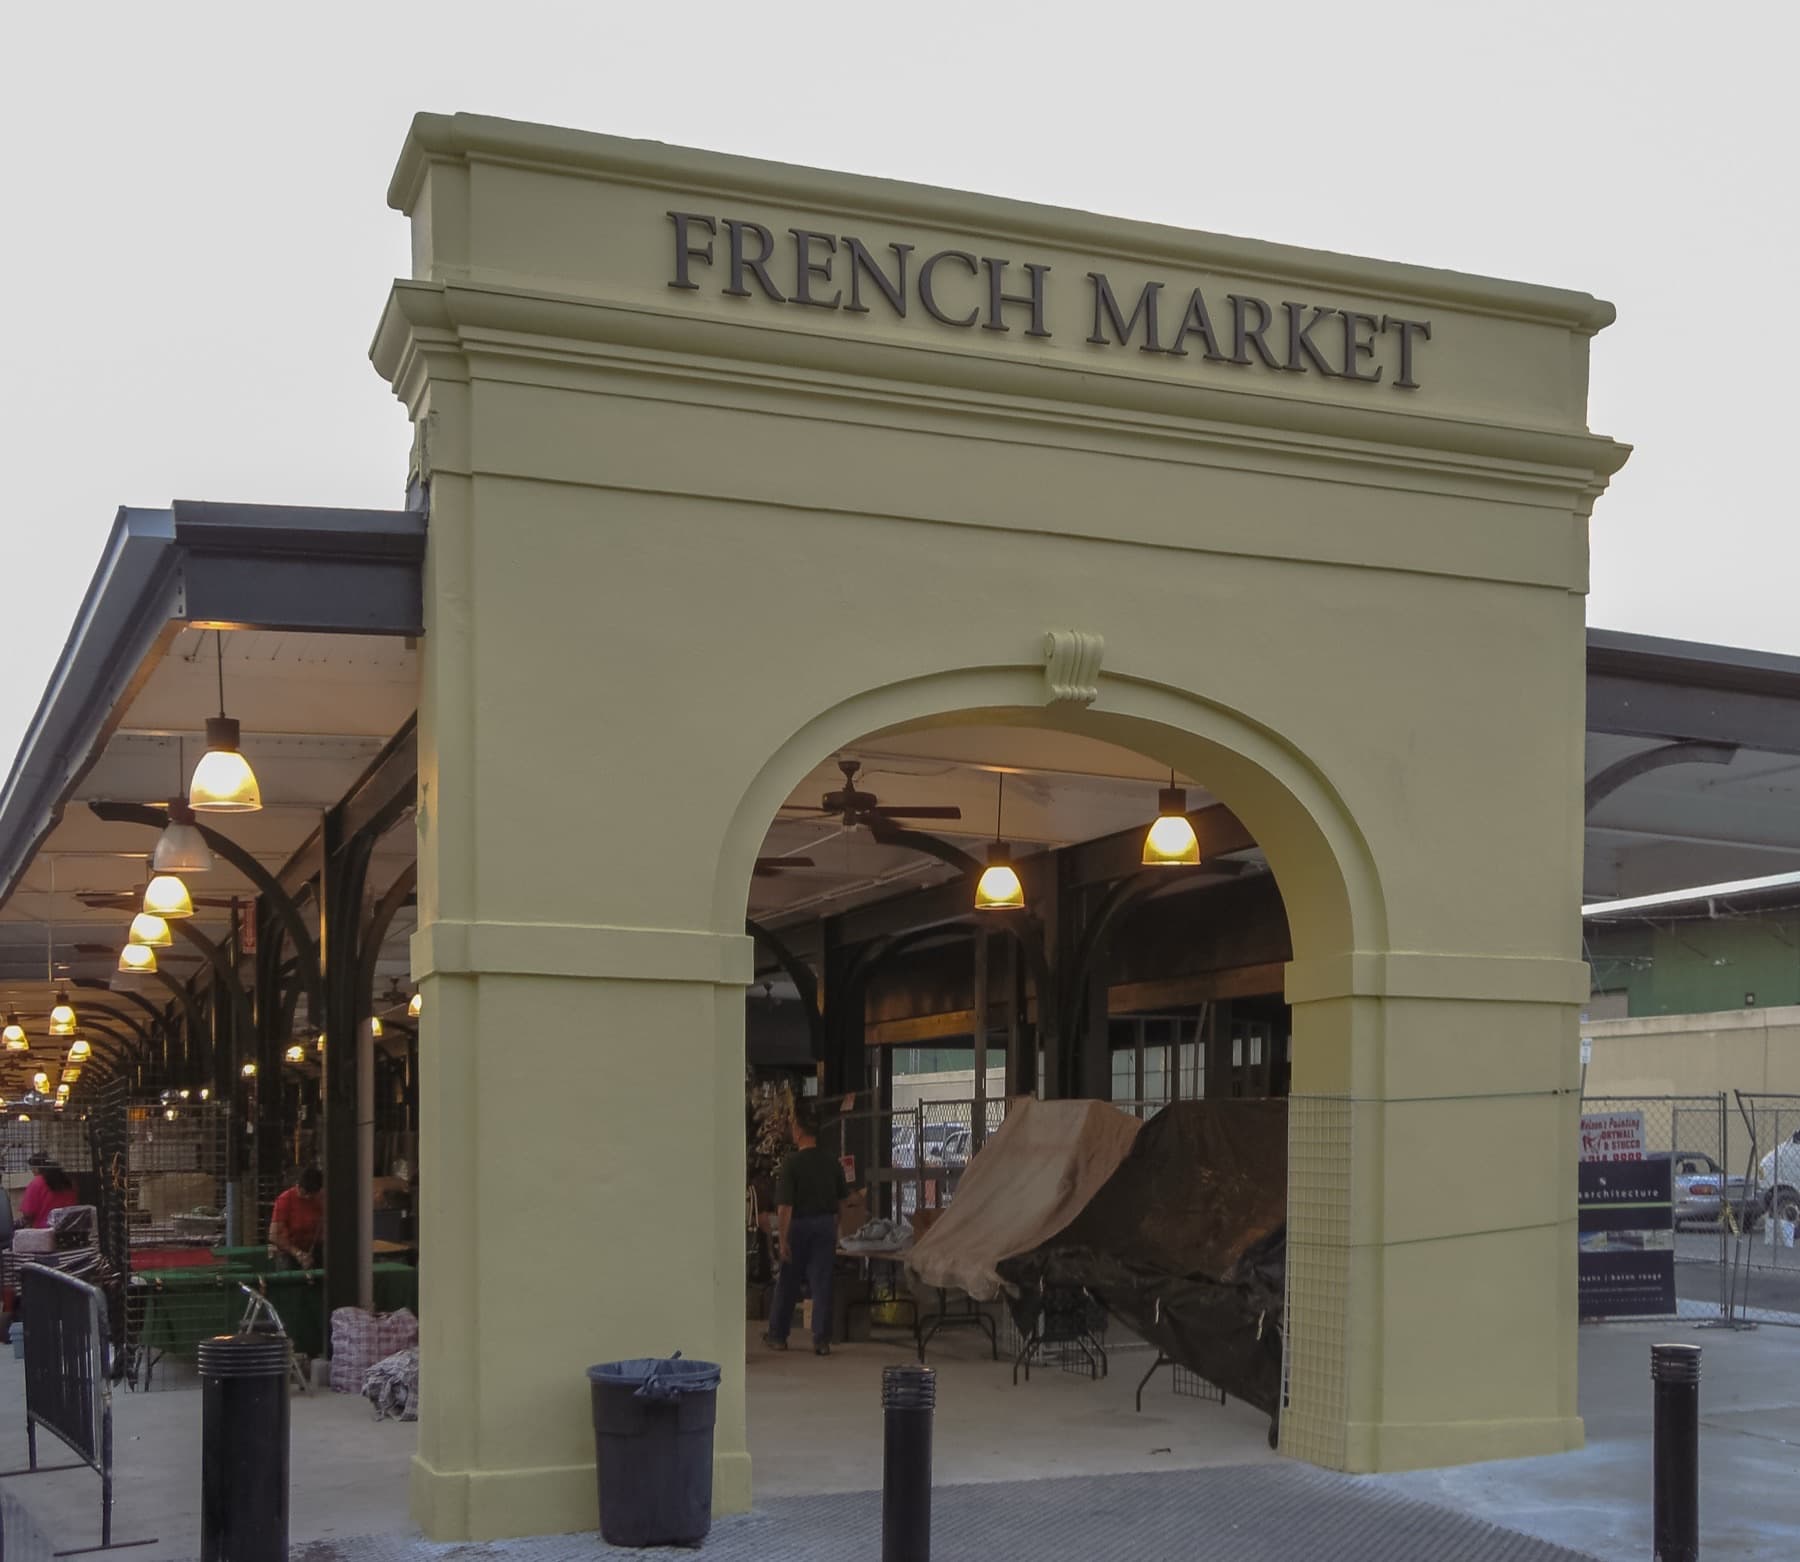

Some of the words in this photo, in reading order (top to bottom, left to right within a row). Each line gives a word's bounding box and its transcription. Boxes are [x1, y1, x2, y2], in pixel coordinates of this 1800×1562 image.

[666, 211, 1051, 338] FRENCH
[1086, 272, 1432, 389] MARKET
[1601, 1129, 1635, 1140] DRYWALL
[1611, 1139, 1641, 1151] STUCCO
